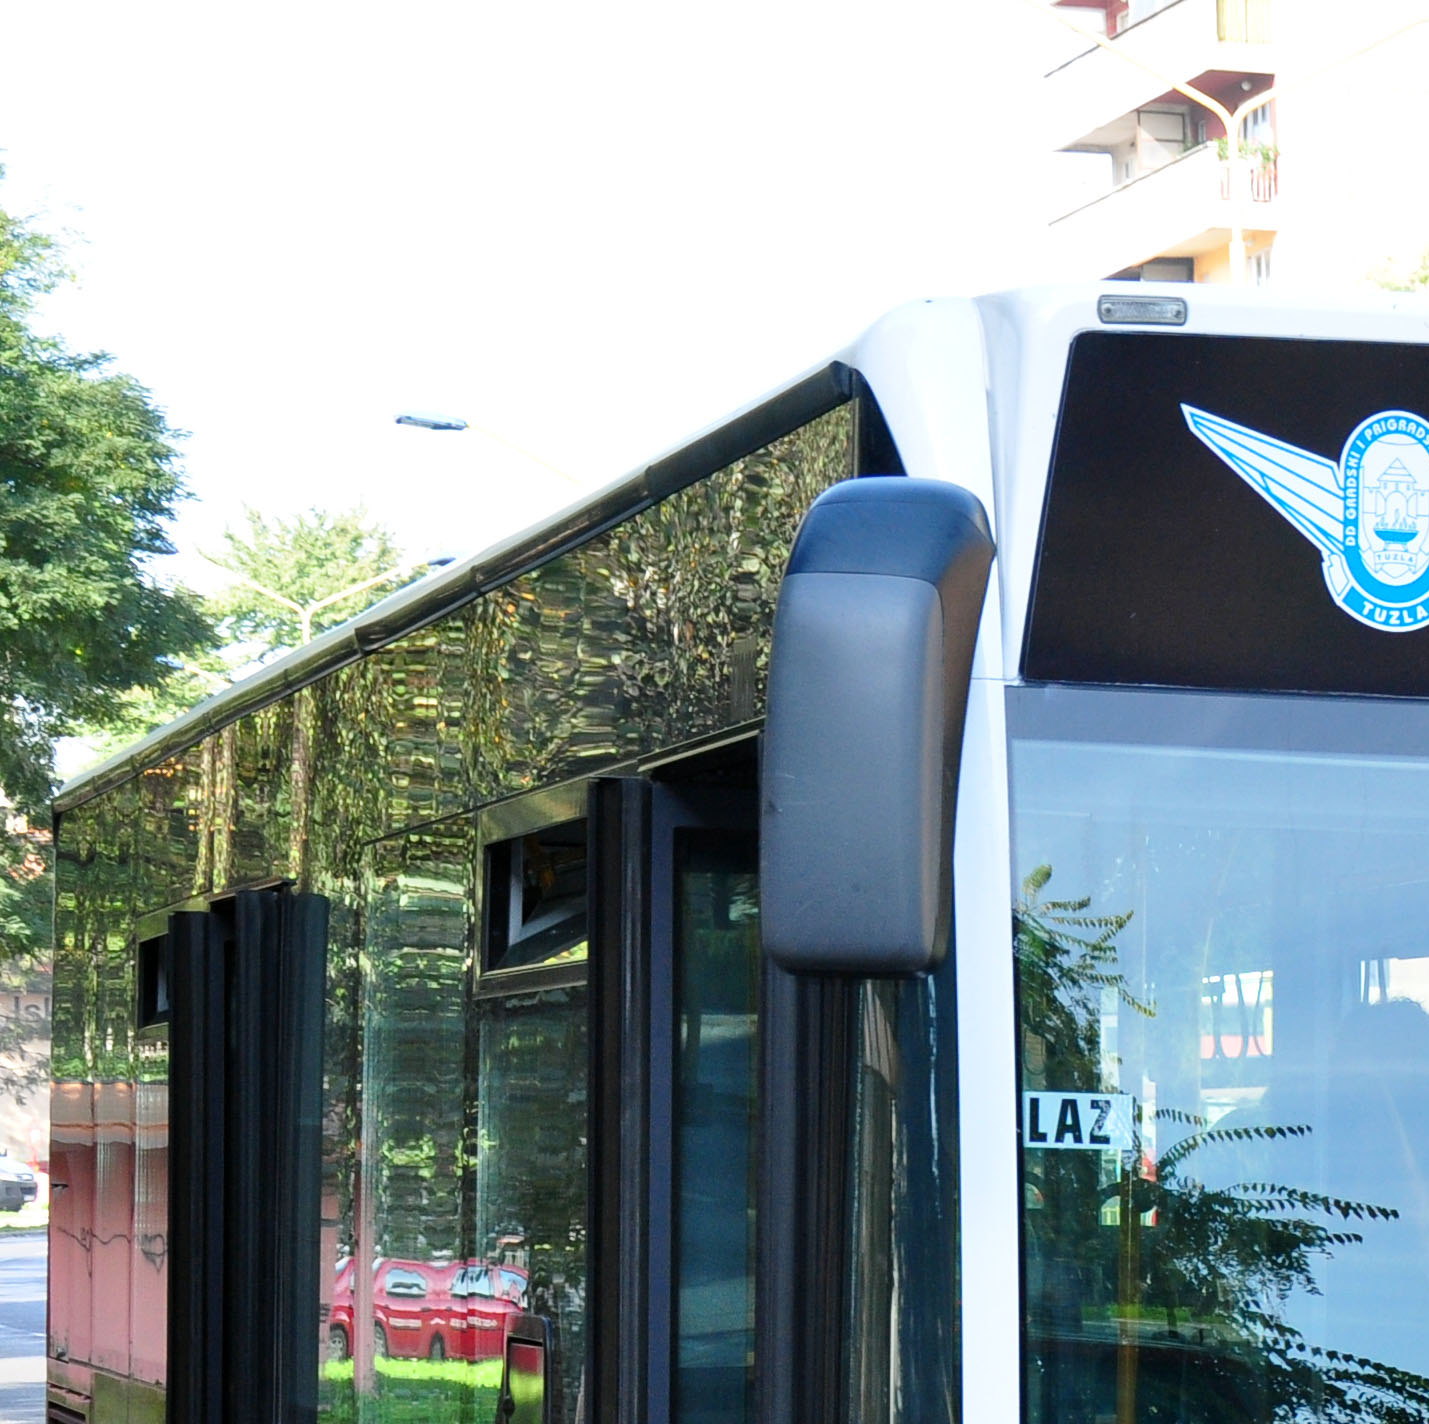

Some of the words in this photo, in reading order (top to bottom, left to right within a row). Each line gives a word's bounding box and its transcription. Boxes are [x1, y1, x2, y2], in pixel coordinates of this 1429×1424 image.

[1346, 452, 1362, 520] GRADSKI
[1362, 600, 1428, 625] TUZLA
[1029, 1097, 1111, 1145] LAZ
